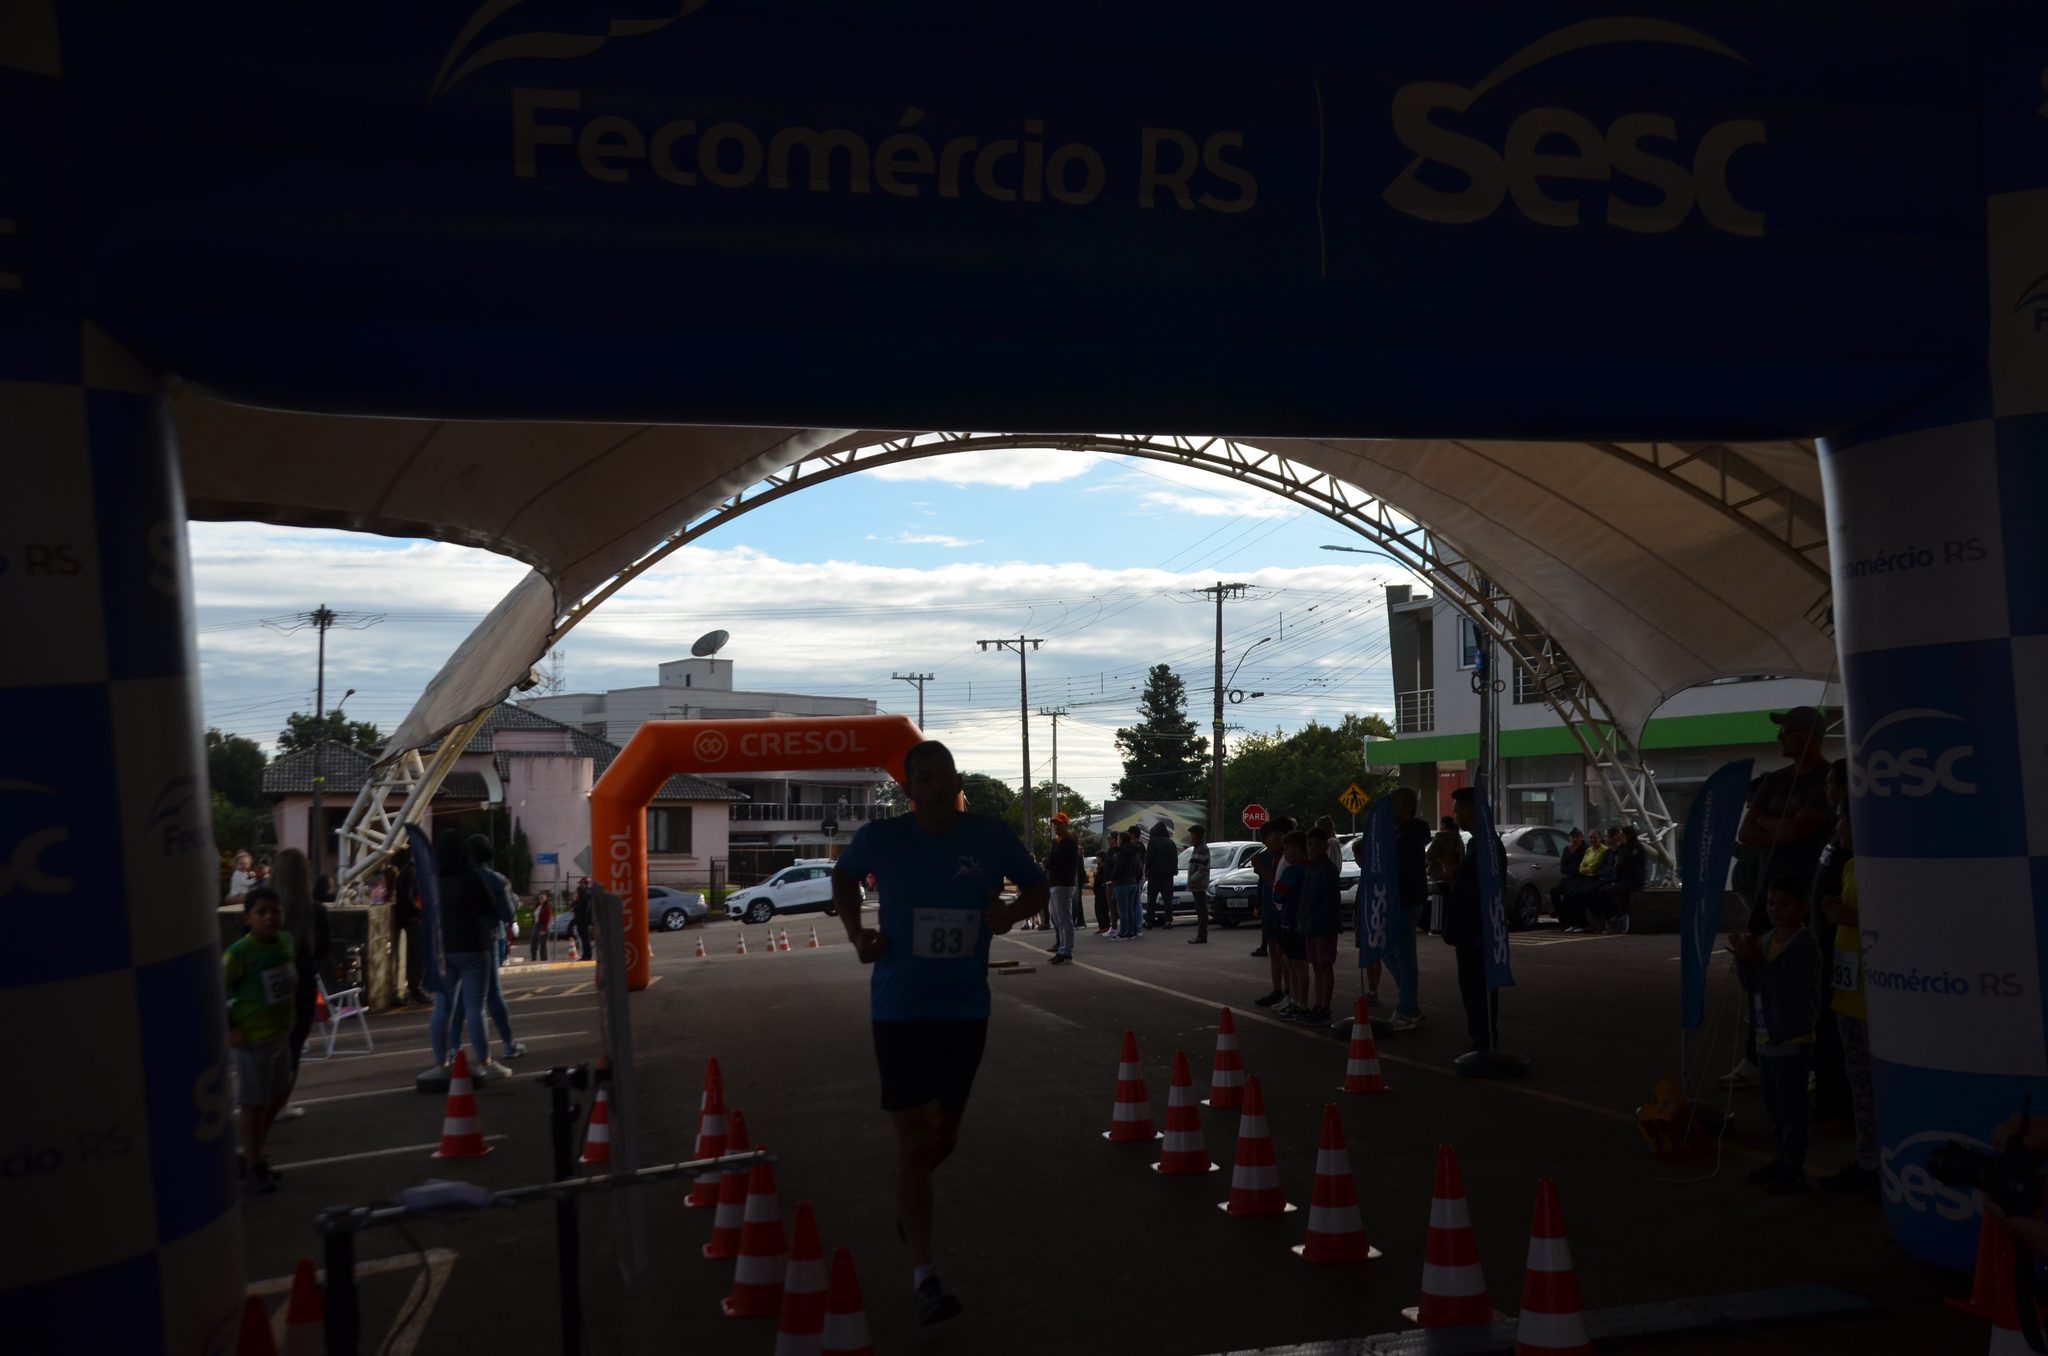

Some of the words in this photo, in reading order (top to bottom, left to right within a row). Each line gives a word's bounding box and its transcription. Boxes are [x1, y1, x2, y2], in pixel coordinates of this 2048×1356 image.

[511, 87, 1107, 206] Fecomércio
[1138, 126, 1258, 214] RS
[1380, 80, 1768, 237] Sesc
[23, 543, 83, 577] RS
[1944, 537, 1987, 564] RS
[739, 729, 867, 757] CRESOL
[1243, 811, 1266, 822] PARE
[931, 927, 962, 954] 83
[1979, 972, 2024, 997] RS
[76, 1123, 132, 1167] RS
